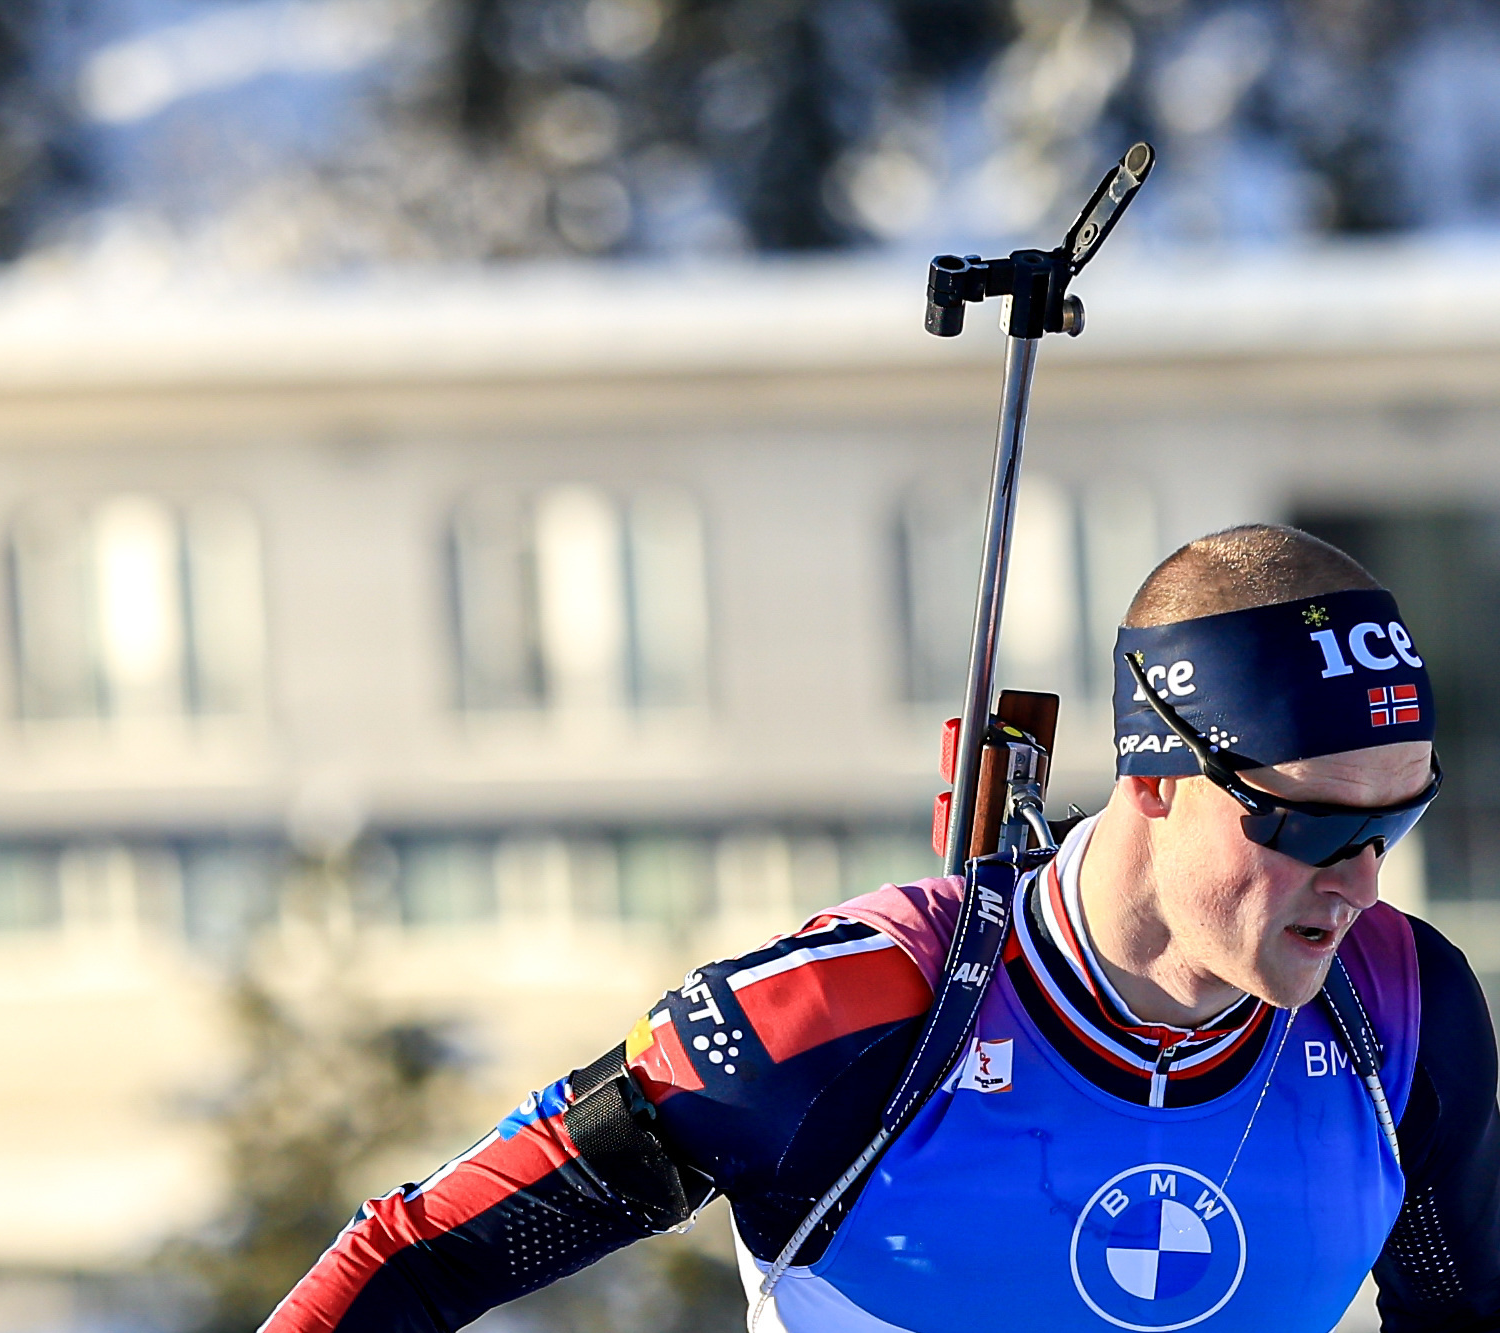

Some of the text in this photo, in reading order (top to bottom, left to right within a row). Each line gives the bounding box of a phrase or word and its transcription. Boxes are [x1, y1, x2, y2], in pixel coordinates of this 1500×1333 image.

[1310, 621, 1423, 679] ice
[1118, 734, 1196, 756] CRAF
[1100, 1173, 1225, 1221] BMW
